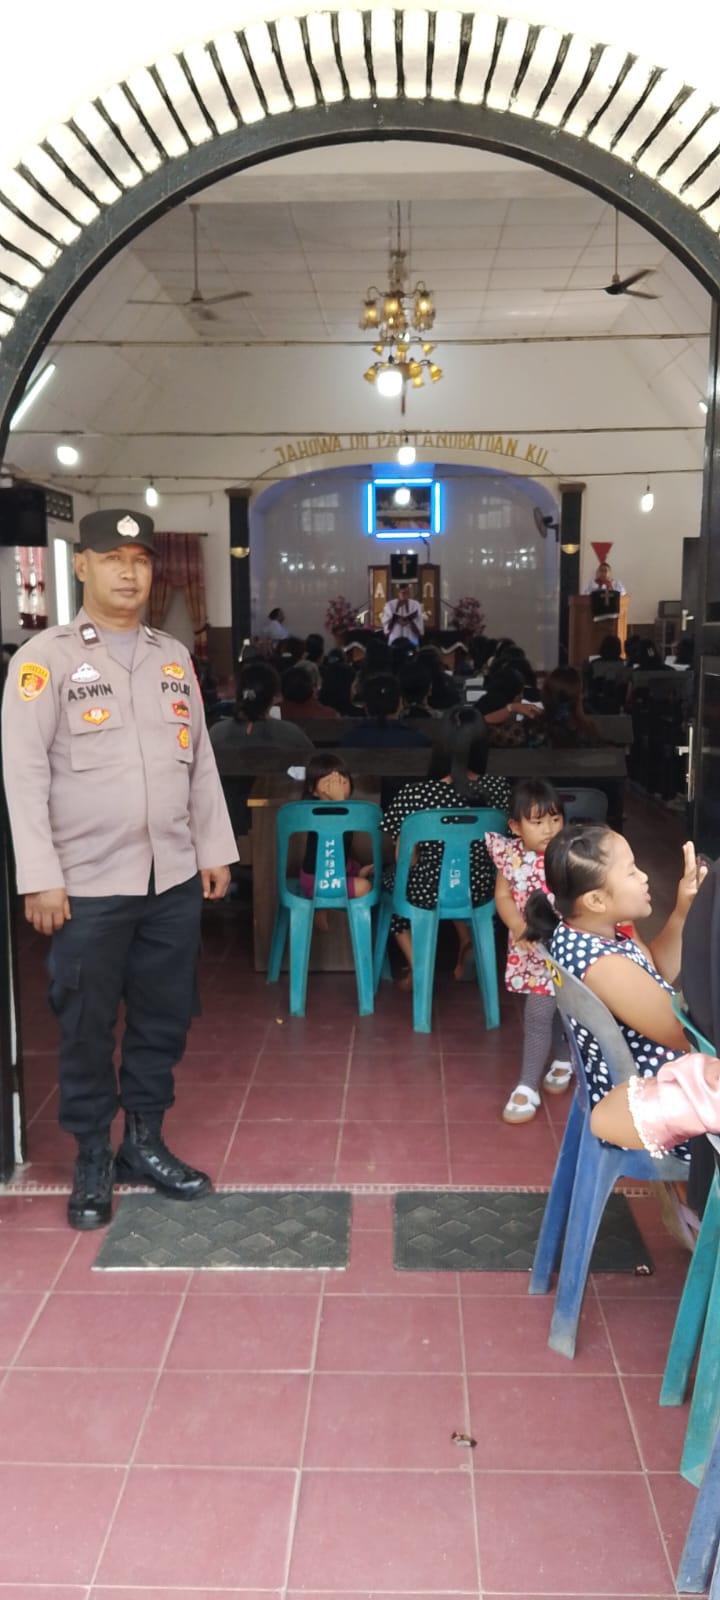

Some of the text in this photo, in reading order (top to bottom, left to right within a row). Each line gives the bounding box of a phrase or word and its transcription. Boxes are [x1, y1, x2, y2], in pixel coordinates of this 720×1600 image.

[274, 432, 342, 465] JAHOWA
[525, 443, 548, 467] KU
[68, 683, 113, 701] ASWIN
